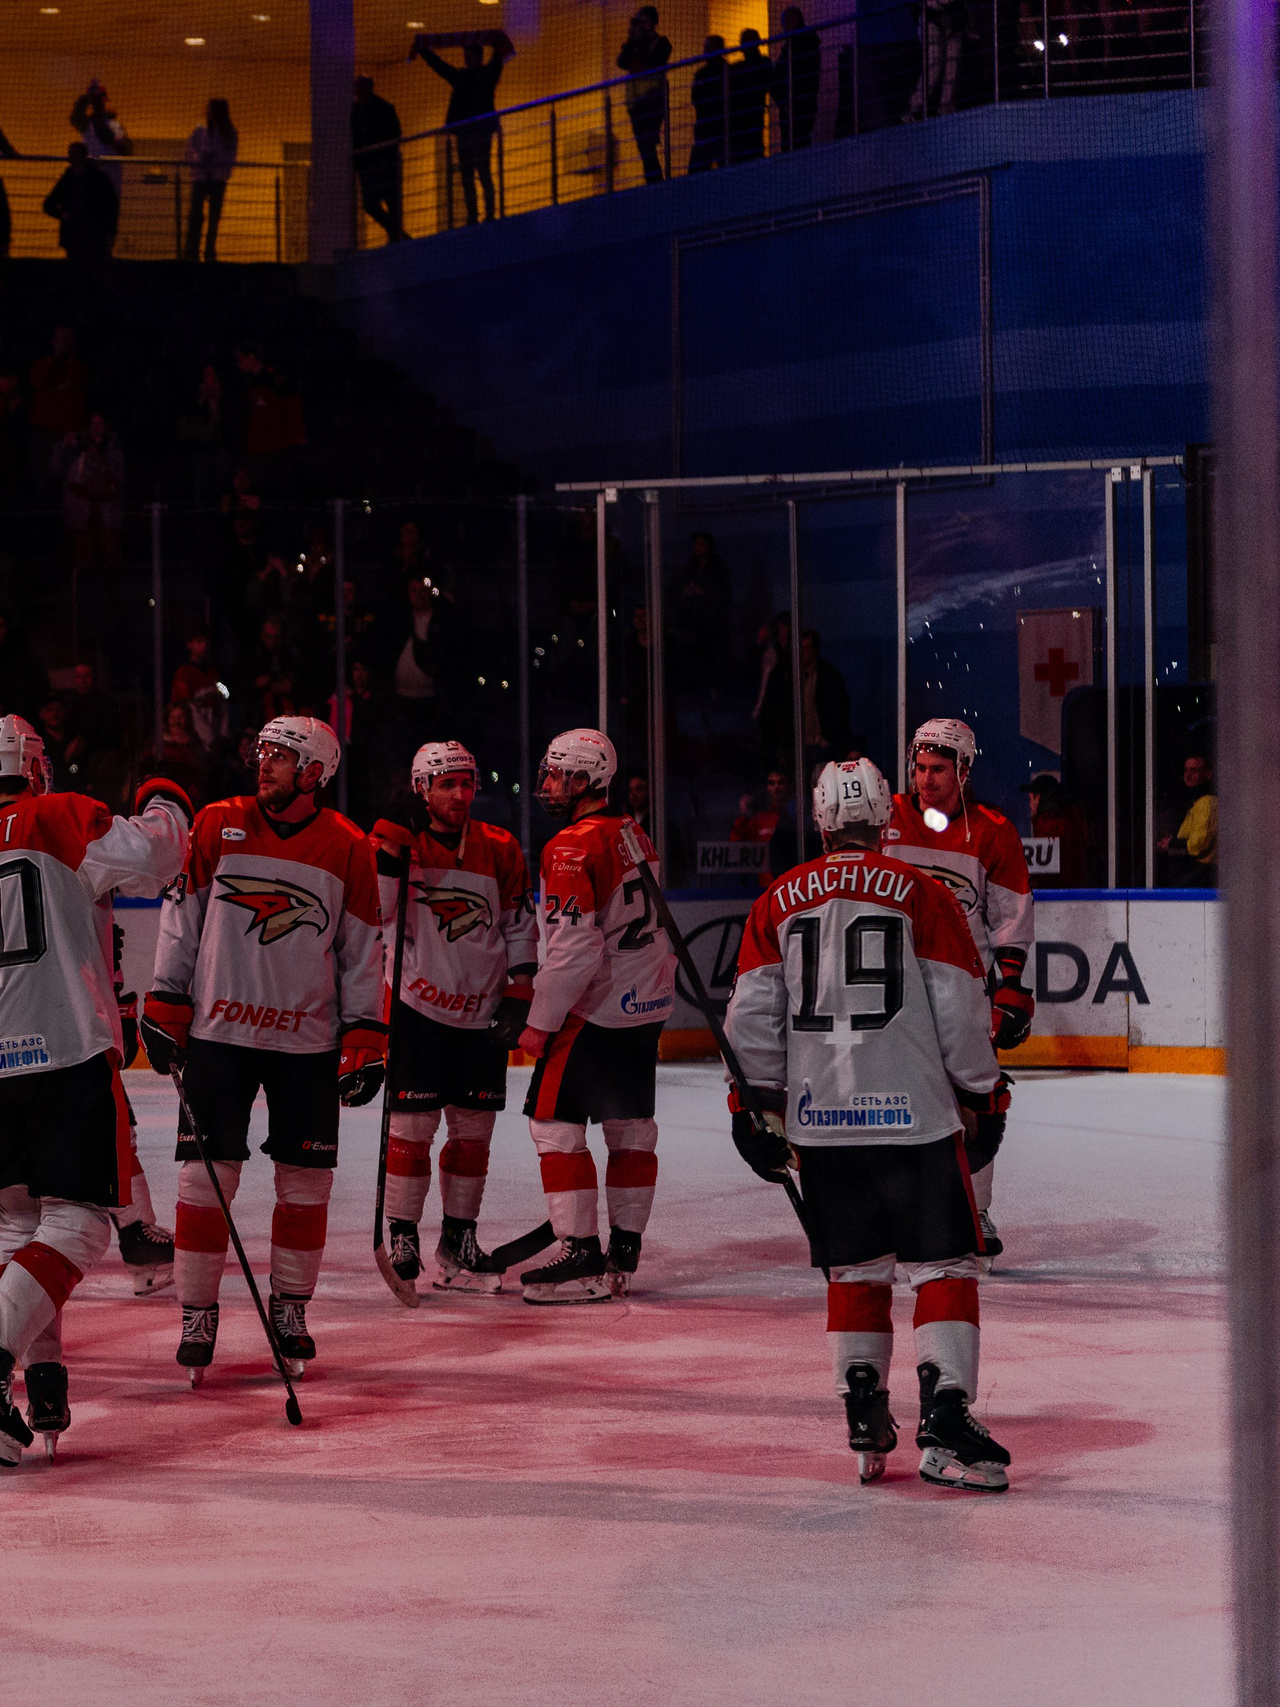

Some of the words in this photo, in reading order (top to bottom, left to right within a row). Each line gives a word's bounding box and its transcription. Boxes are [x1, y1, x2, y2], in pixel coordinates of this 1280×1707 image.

[842, 780, 863, 800] 19
[773, 865, 914, 913] TKACHYOV
[545, 893, 583, 926] 24
[618, 877, 658, 950] 2
[789, 915, 904, 1031] 19
[1036, 941, 1150, 1004] DA
[408, 977, 487, 1013] FONBET
[209, 999, 307, 1033] FONBET
[21, 1037, 43, 1047] АЗС
[812, 1108, 912, 1126] ГАЗПРОМНЕФТЬ
[852, 1096, 882, 1106] СЕТЬ
[884, 1096, 908, 1105] АЗС
